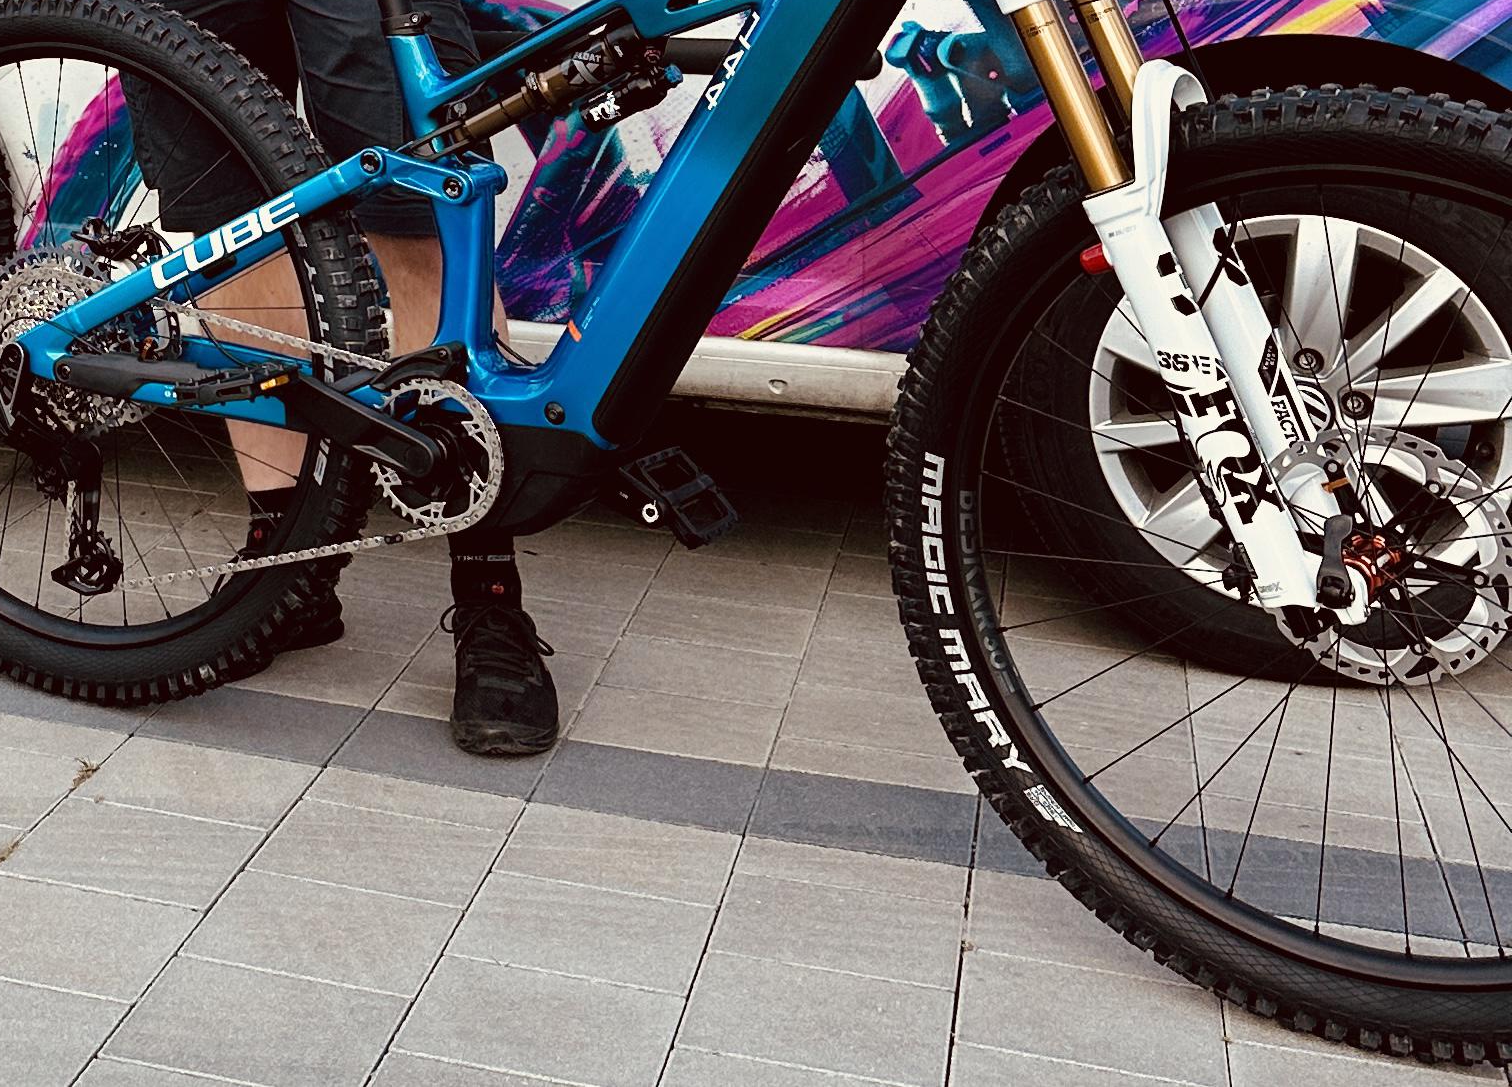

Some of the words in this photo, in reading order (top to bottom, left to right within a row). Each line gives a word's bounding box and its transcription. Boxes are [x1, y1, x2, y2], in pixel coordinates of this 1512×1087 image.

[151, 191, 300, 290] CUBE
[1270, 396, 1301, 449] FACT
[922, 451, 955, 615] MAGIC
[938, 628, 1035, 774] MARY
